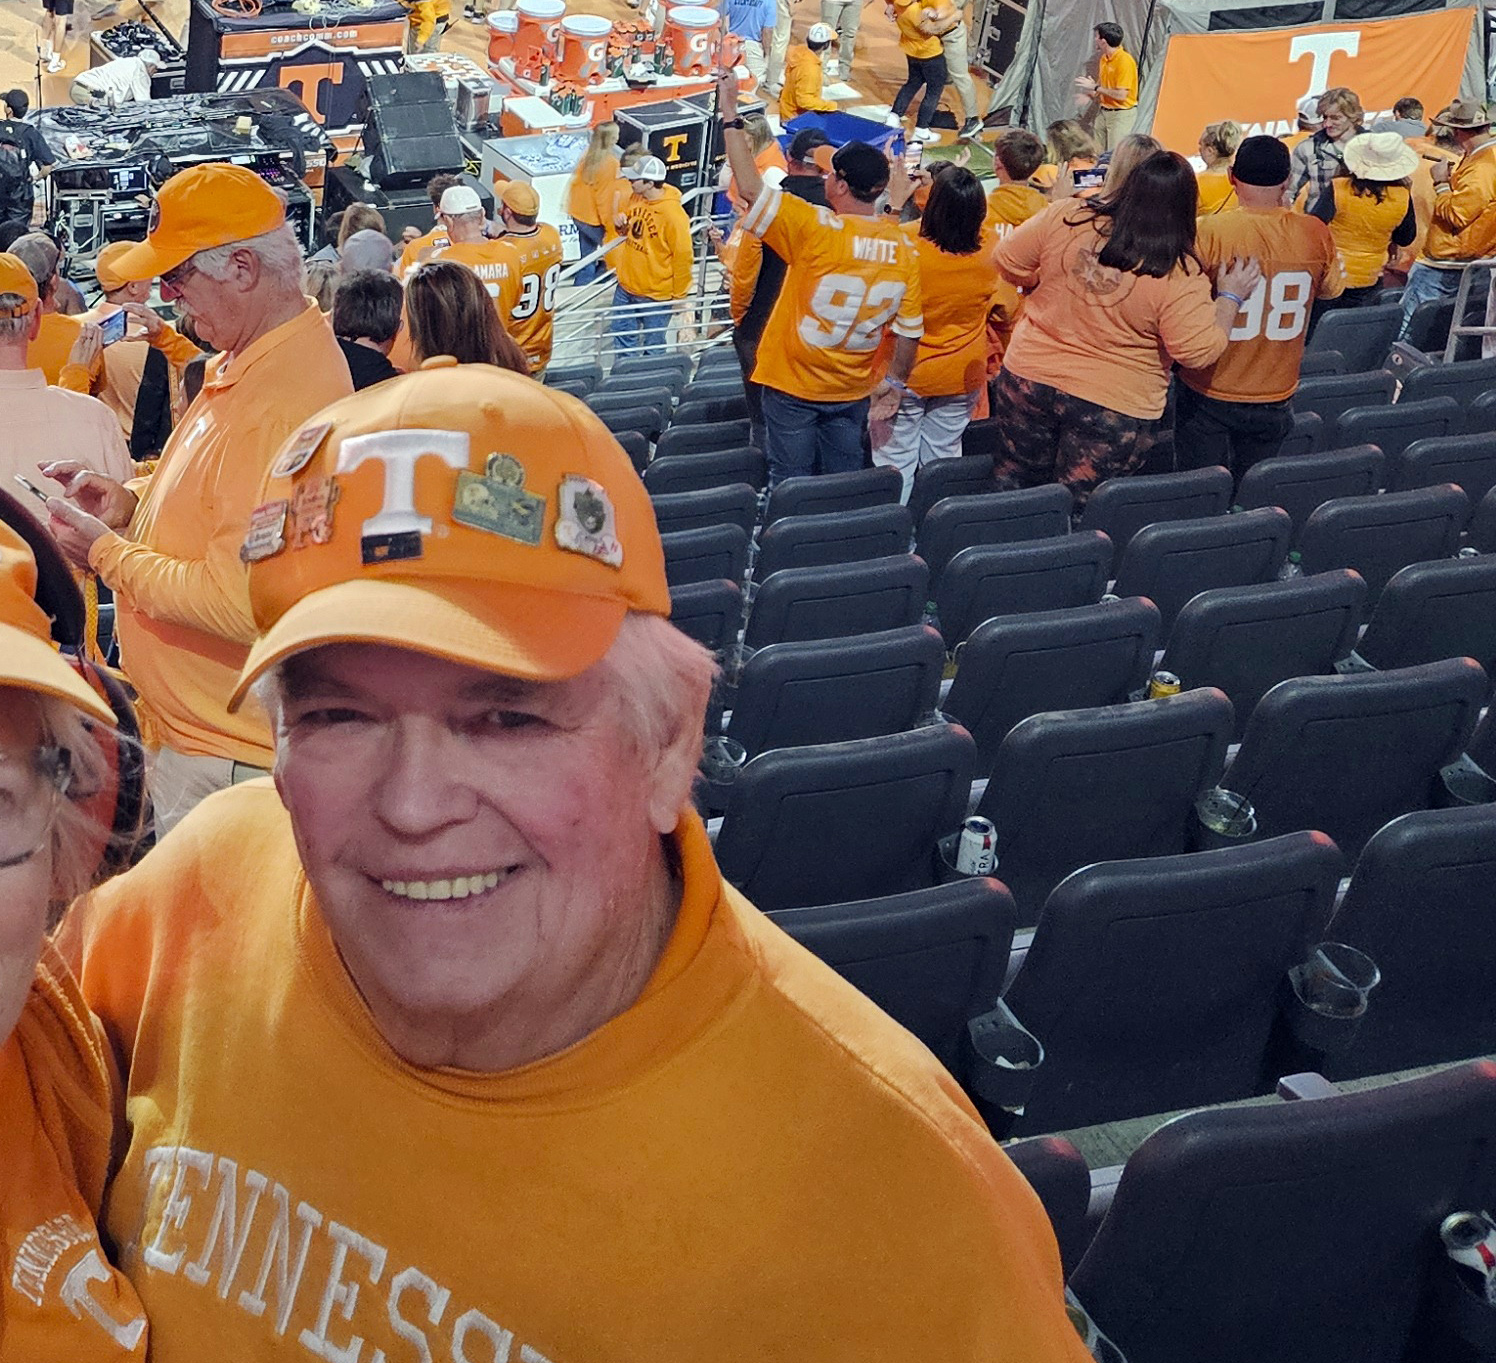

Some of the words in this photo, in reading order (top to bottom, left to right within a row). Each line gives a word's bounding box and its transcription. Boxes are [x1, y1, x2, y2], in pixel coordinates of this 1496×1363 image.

[270, 29, 358, 44] coachcomm.com
[690, 33, 708, 53] G
[588, 42, 606, 61] G
[1288, 31, 1362, 112] T
[280, 62, 344, 125] T
[661, 133, 685, 162] T
[854, 236, 899, 265] WHITE
[473, 263, 509, 279] AMARA
[511, 263, 561, 319] 98
[799, 274, 907, 352] 92
[336, 429, 470, 537] T
